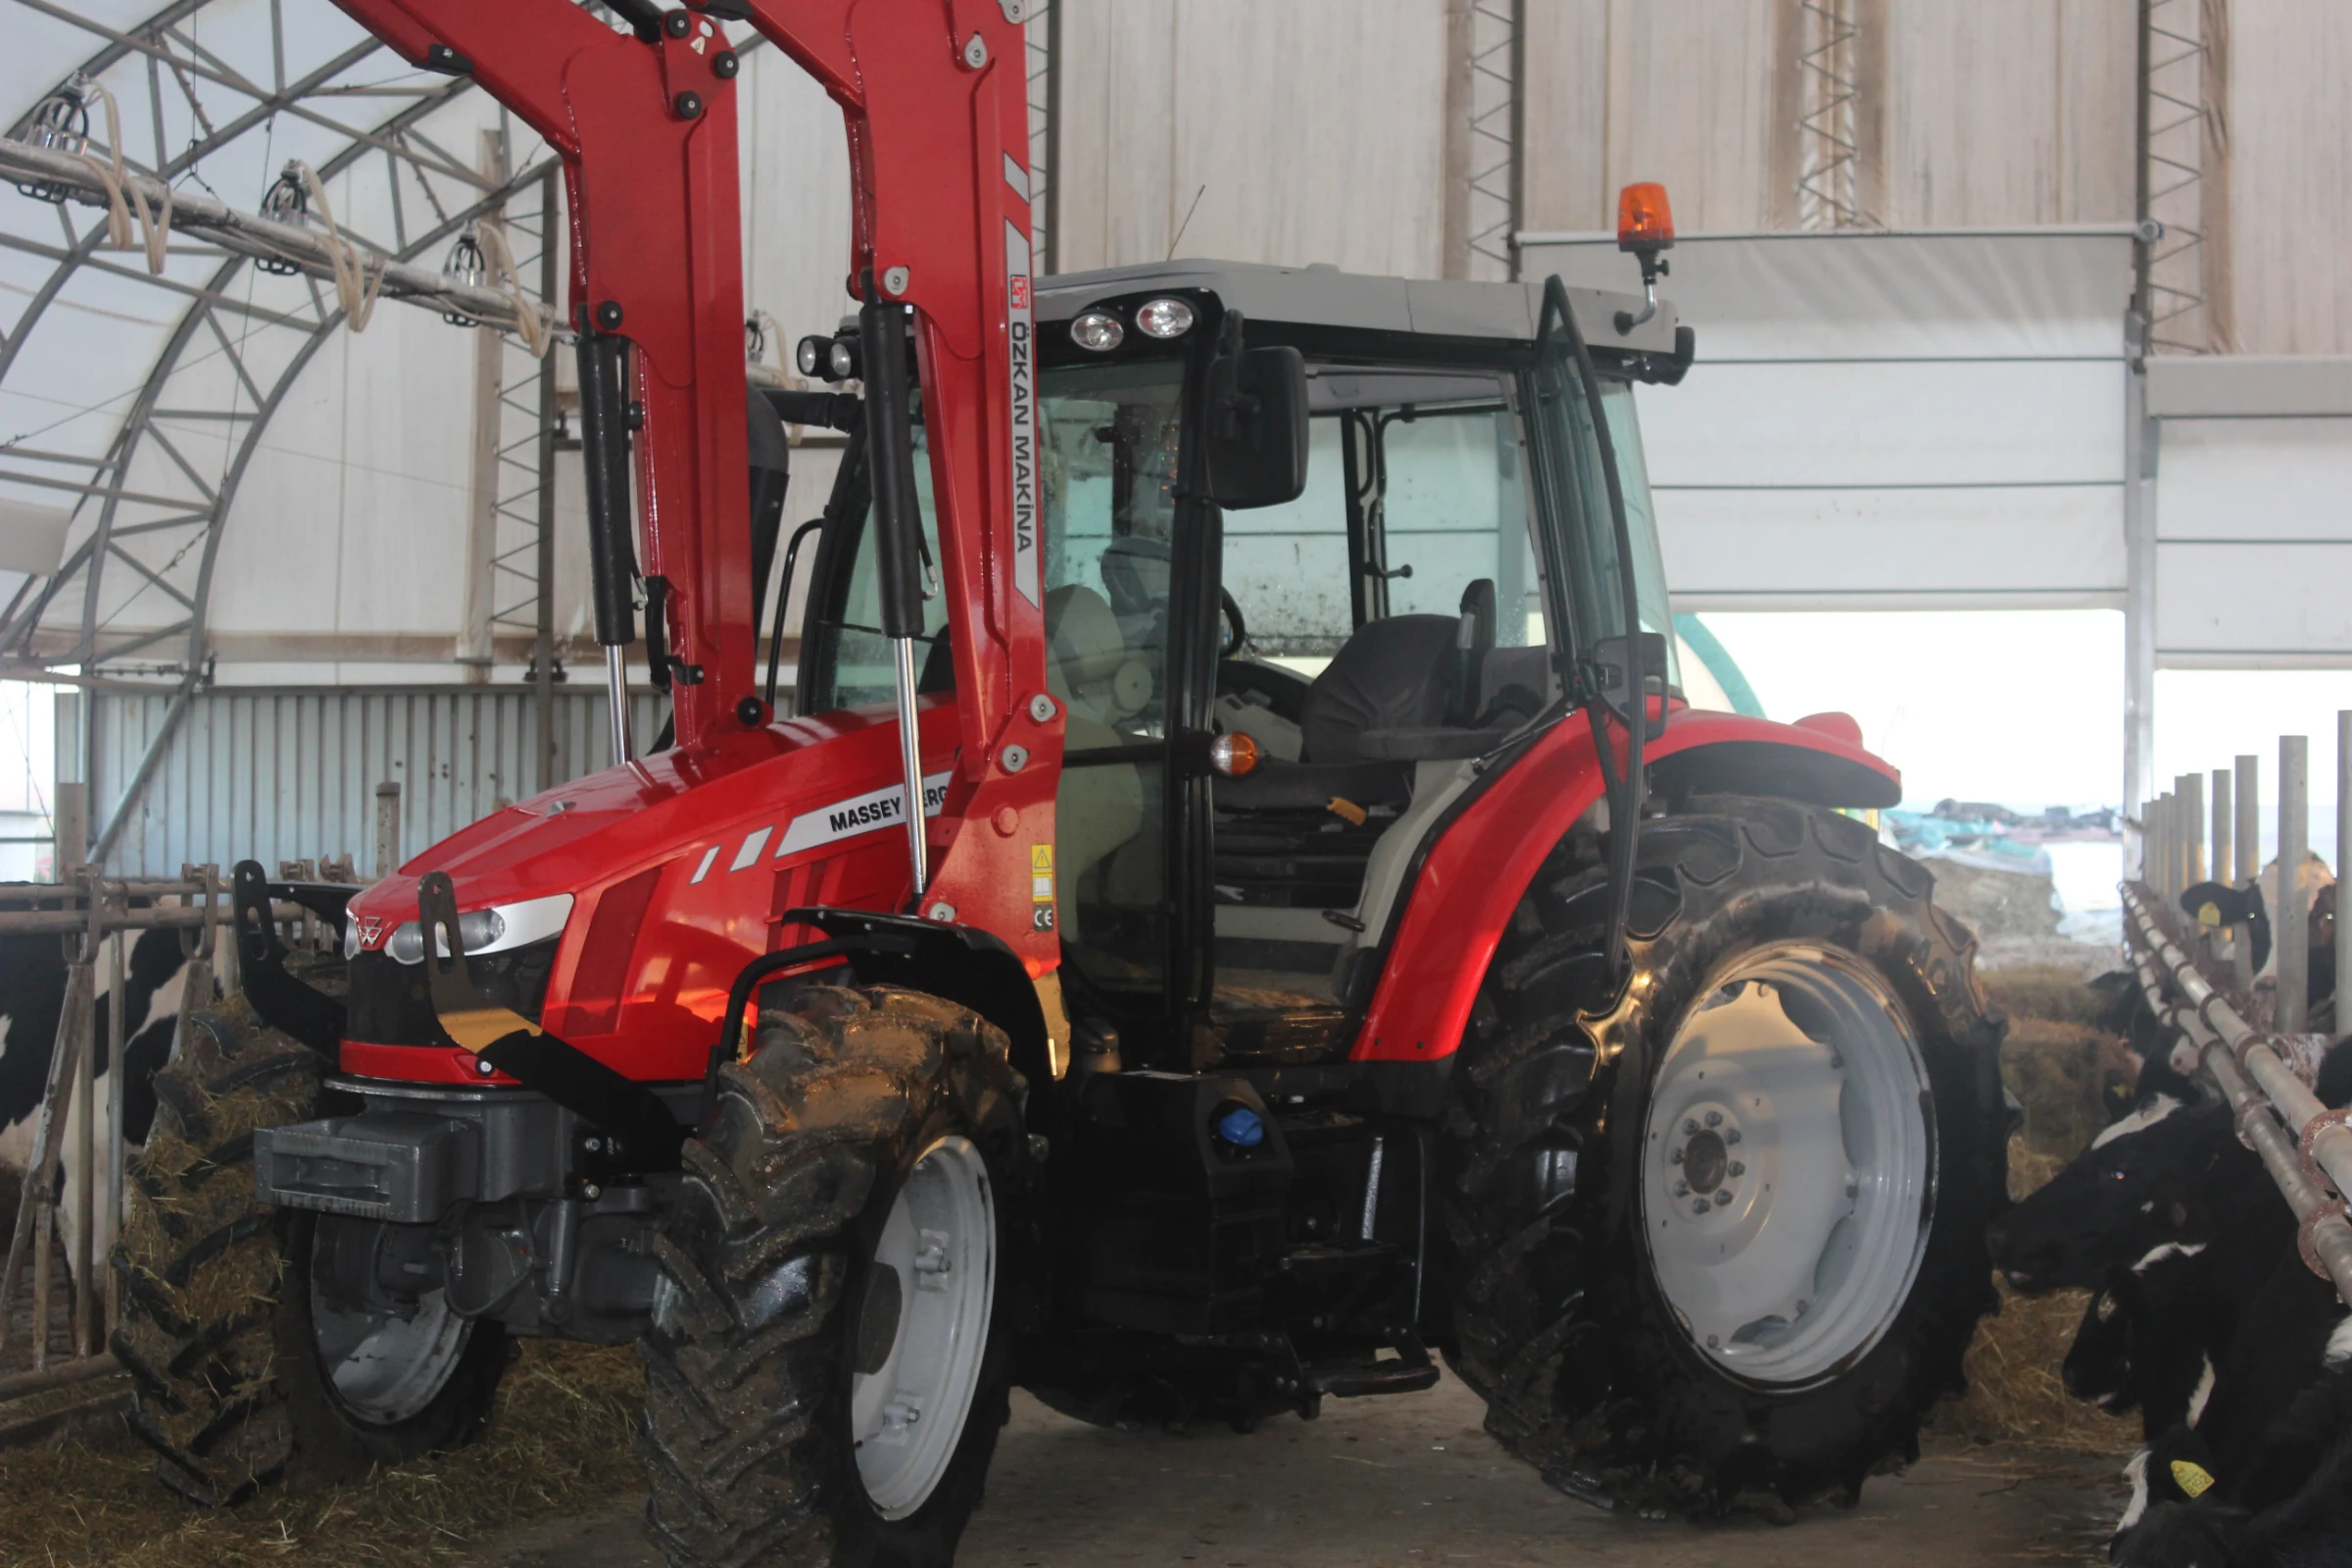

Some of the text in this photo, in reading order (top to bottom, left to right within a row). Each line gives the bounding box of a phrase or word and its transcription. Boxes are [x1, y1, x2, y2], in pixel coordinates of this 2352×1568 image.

[1011, 321, 1030, 424] ÖZKAN
[1014, 435, 1035, 553] MAKİNA
[829, 797, 901, 832] MASSEY
[1034, 909, 1053, 927] CE
